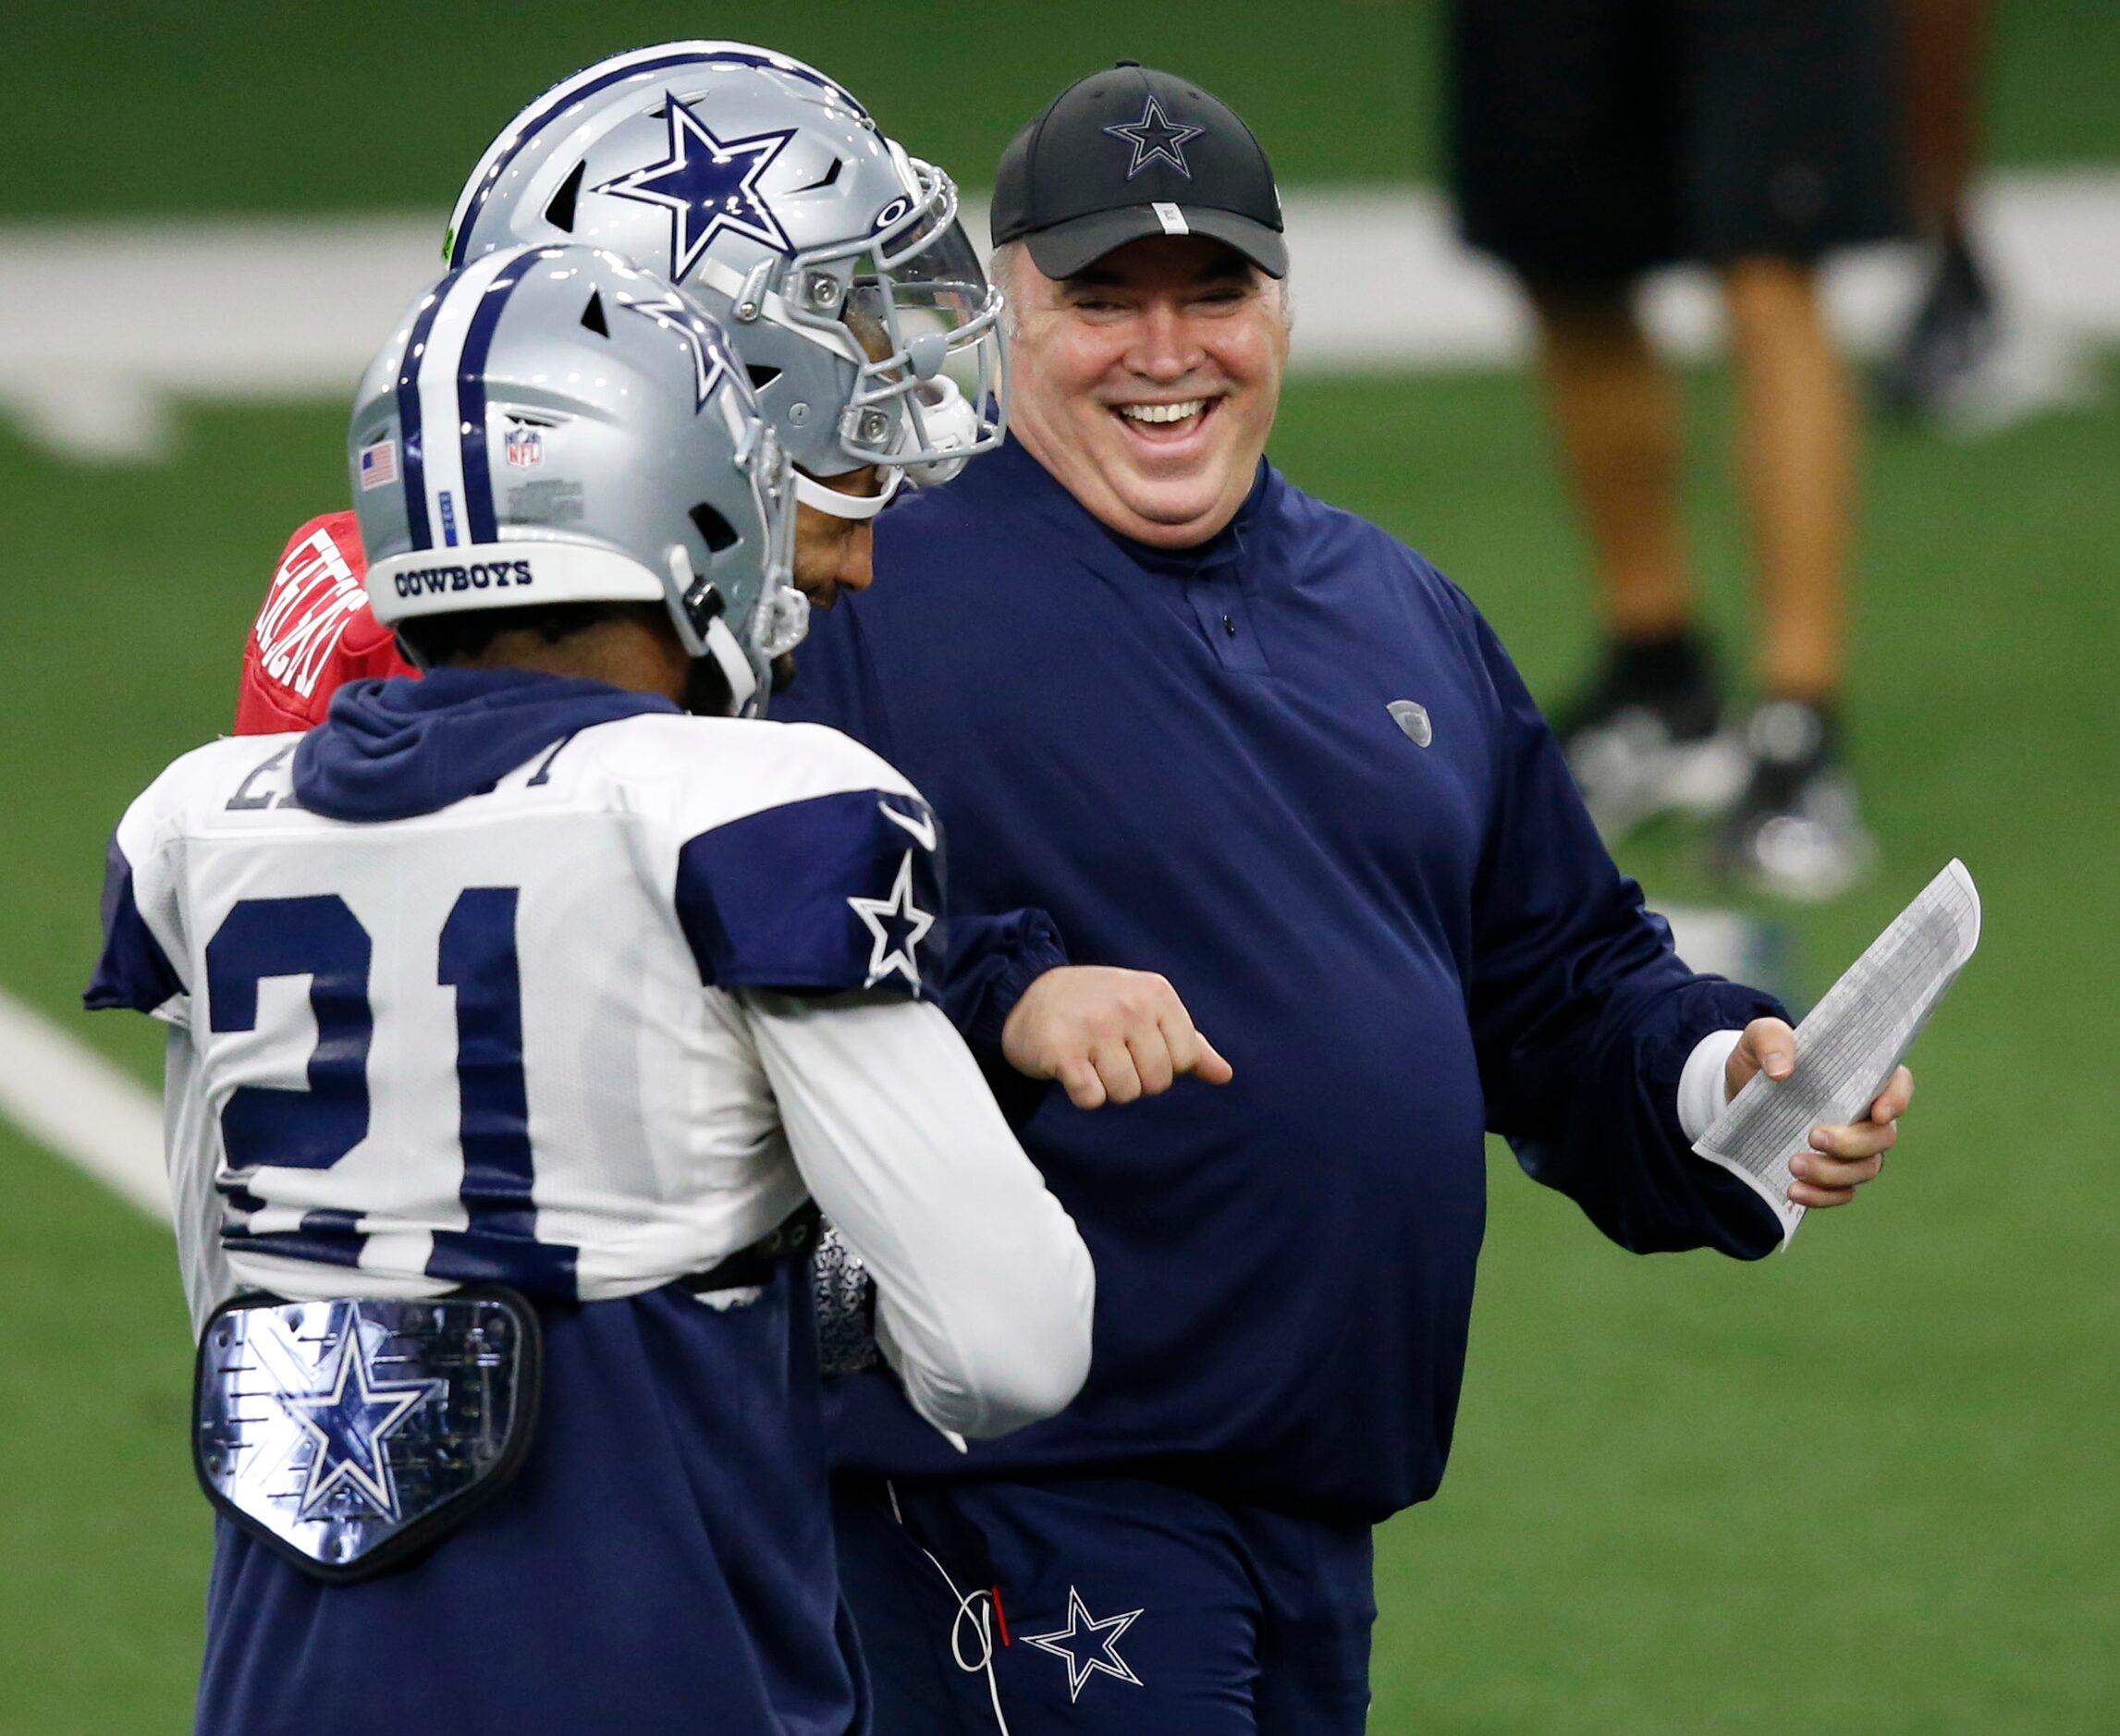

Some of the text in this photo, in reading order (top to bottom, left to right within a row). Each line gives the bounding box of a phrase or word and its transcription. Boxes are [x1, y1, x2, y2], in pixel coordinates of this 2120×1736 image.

[509, 445, 540, 466] NFL
[395, 560, 533, 597] COWBOYS
[205, 886, 580, 1300] 21
